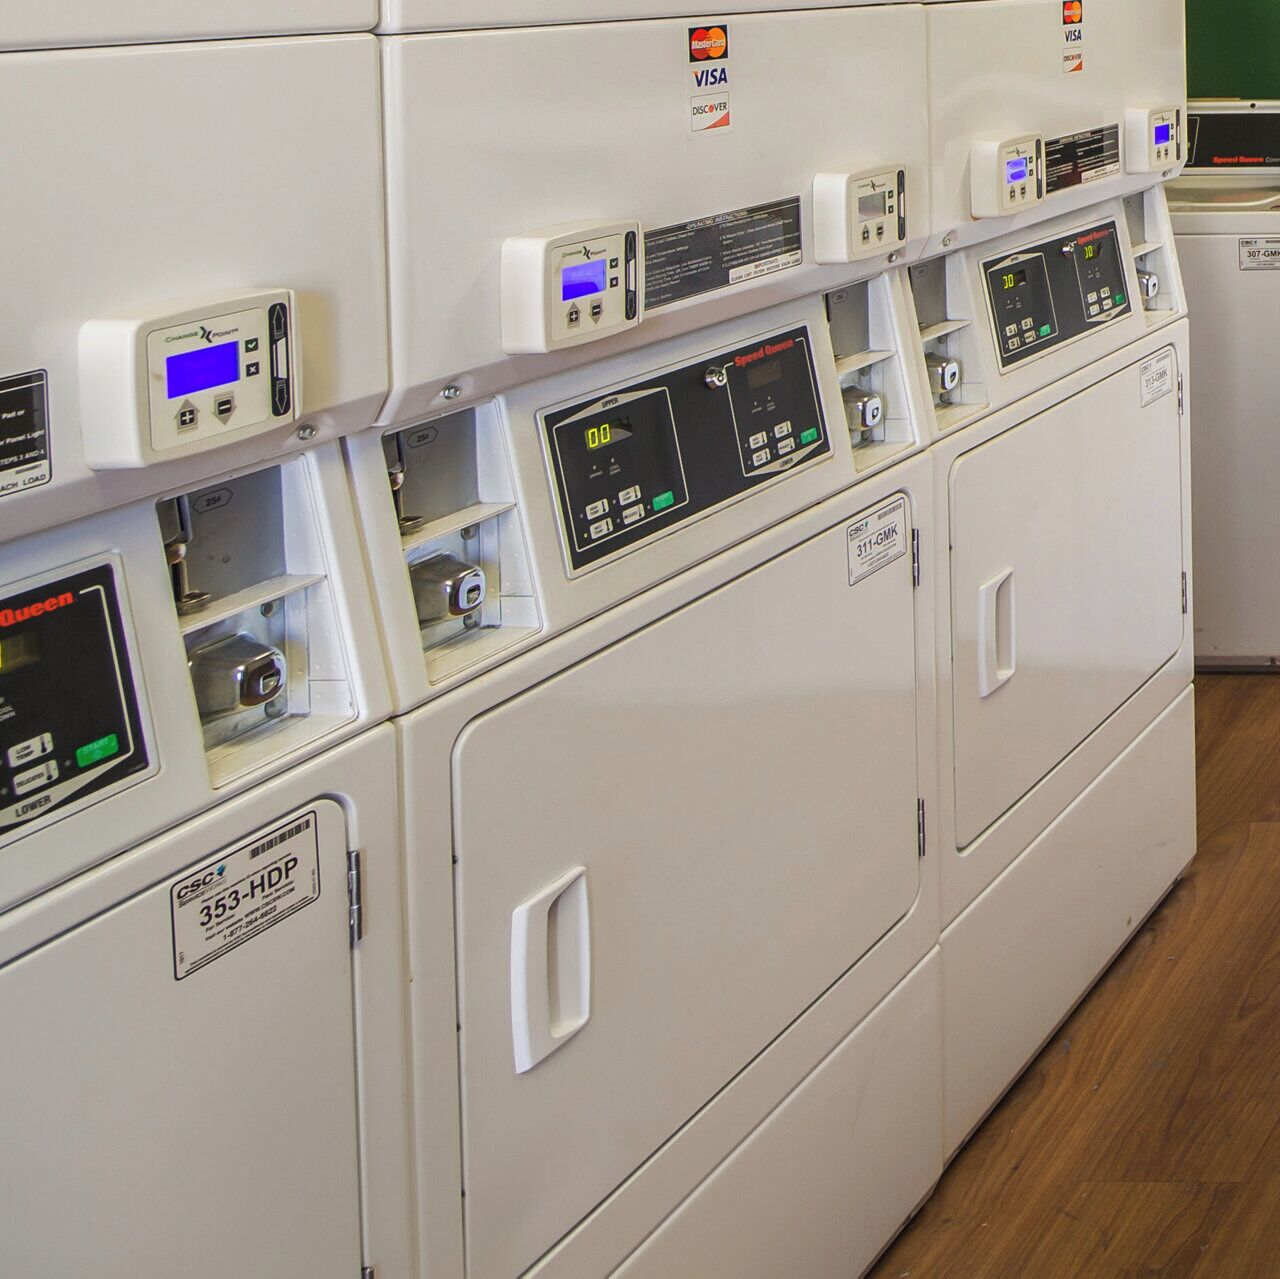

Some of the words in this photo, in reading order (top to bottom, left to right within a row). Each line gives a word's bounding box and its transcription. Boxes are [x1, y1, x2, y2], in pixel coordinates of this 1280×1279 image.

[1064, 28, 1082, 43] VISA
[691, 38, 725, 50] MasterCard
[691, 67, 728, 88] VISA
[692, 101, 728, 116] DISCOVER
[1212, 156, 1238, 164] Speed
[1238, 155, 1264, 163] Queen
[165, 330, 199, 343] CHANGE
[735, 349, 765, 368] Speed
[765, 337, 794, 357] Queen
[601, 396, 619, 409] UPPER
[2, 411, 16, 419] Pad
[22, 474, 46, 486] LOAD
[849, 523, 864, 537] CSC
[857, 523, 898, 558] 311-GMK
[0, 592, 74, 628] Queen
[16, 750, 34, 762] TEMP
[15, 795, 51, 818] LOWER
[177, 871, 215, 900] CSC
[199, 857, 298, 927] 353-HDP
